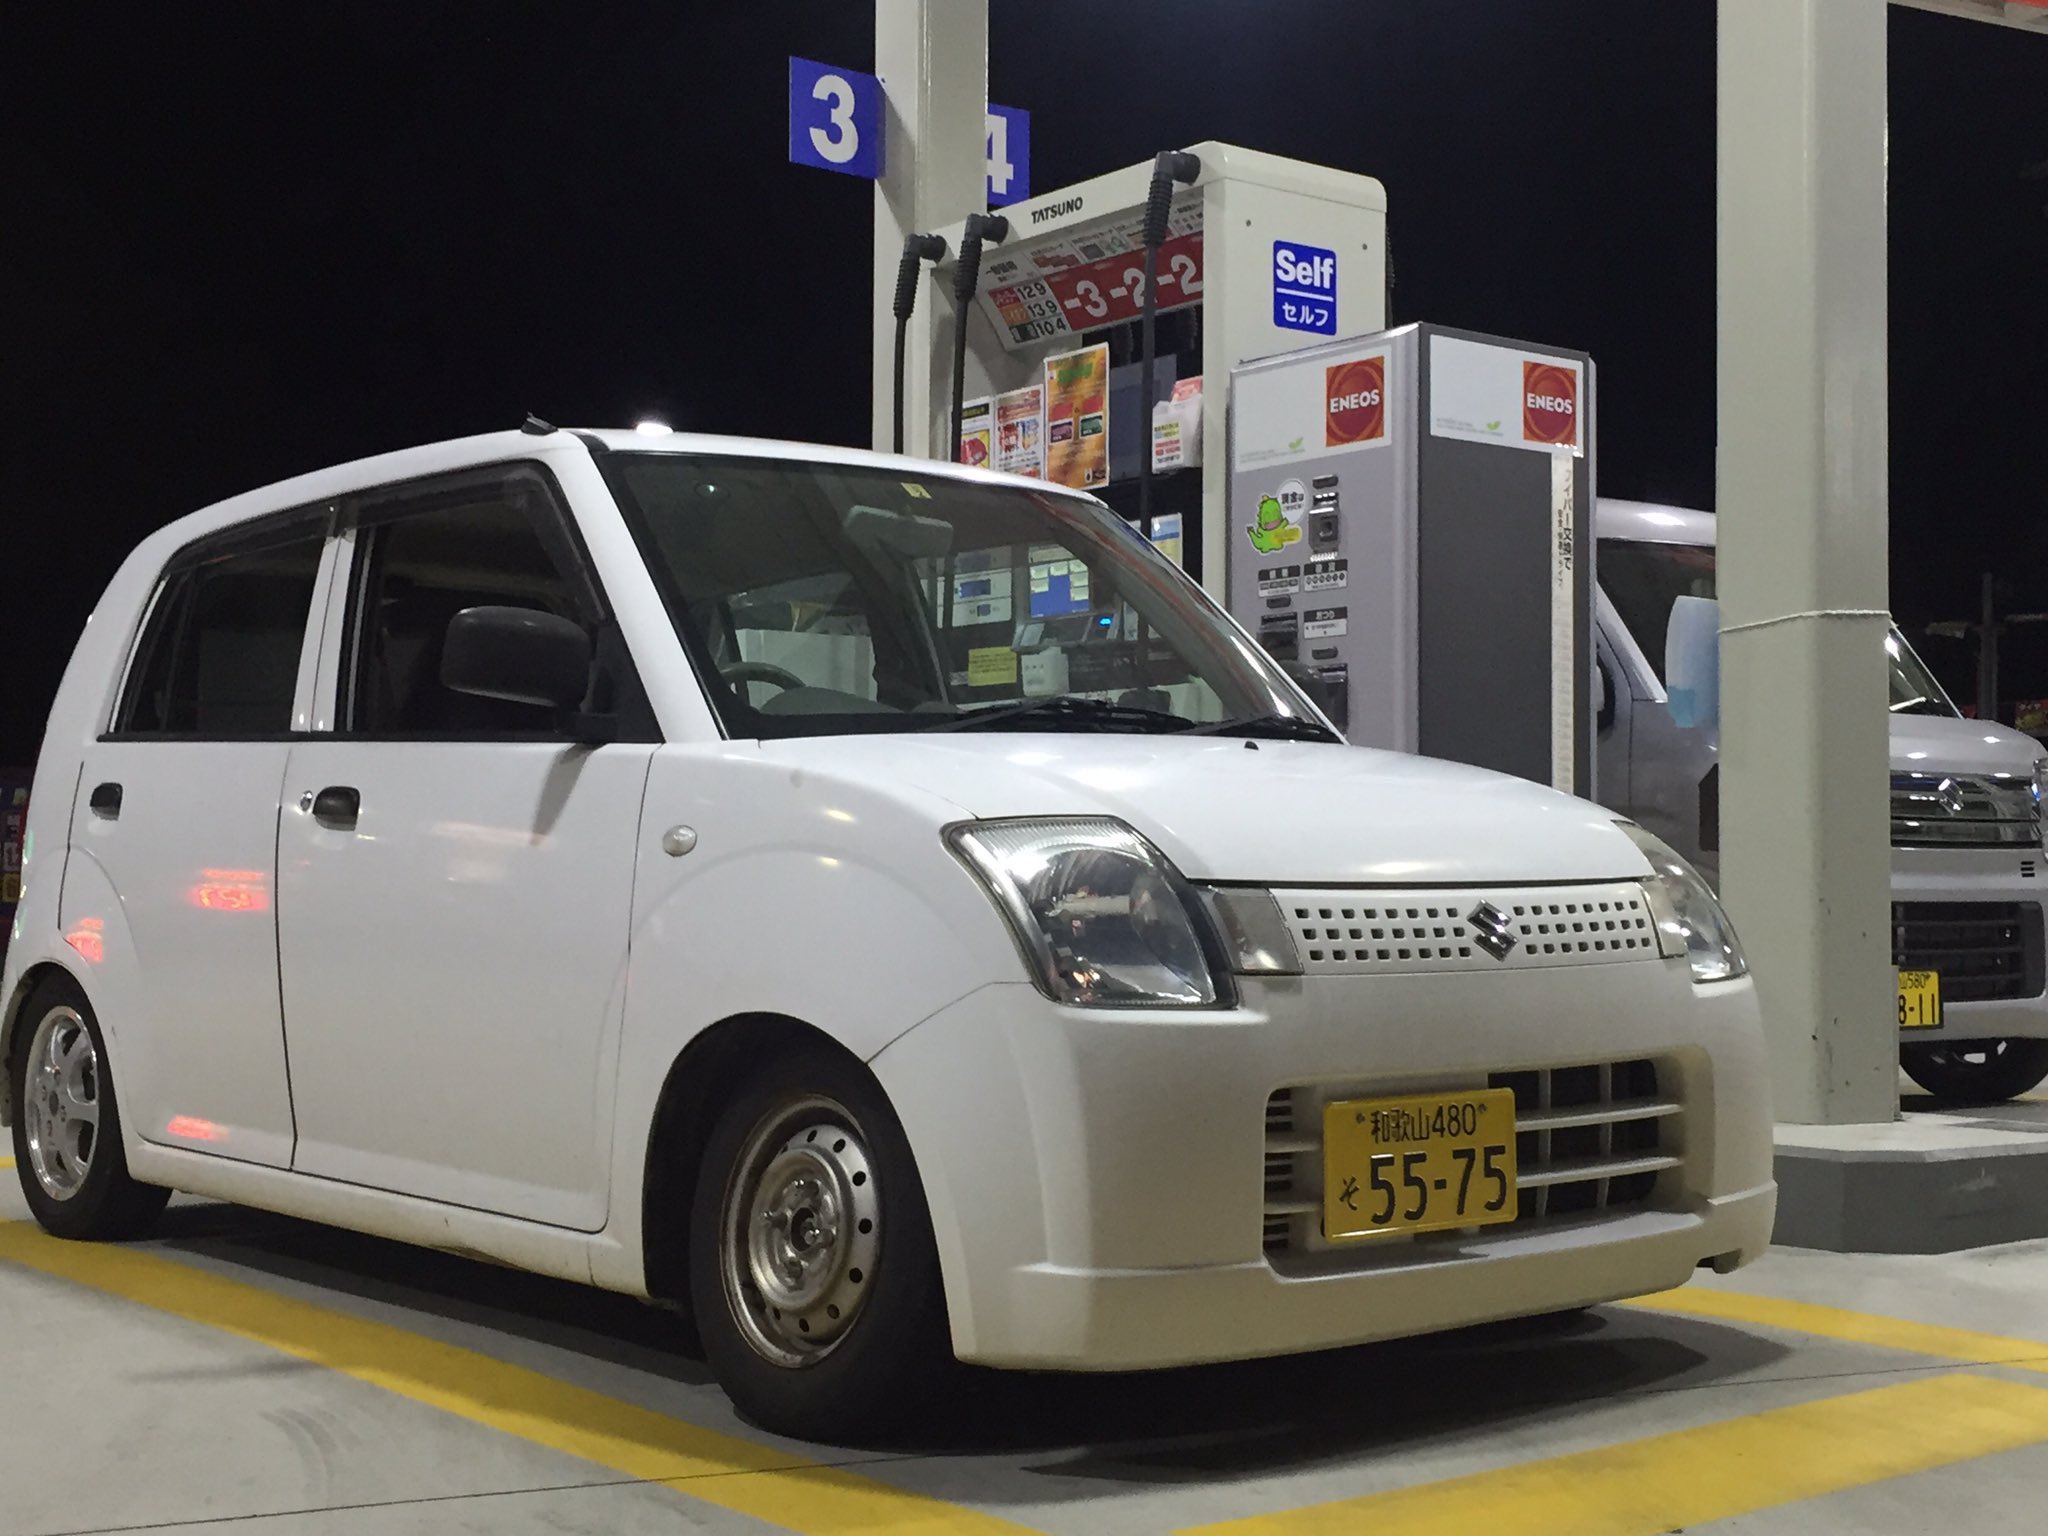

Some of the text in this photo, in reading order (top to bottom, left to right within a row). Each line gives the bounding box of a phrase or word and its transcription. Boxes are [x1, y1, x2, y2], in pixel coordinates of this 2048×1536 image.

[809, 74, 859, 164] 3
[987, 113, 1014, 195] 4
[1031, 196, 1084, 224] TATSUNO
[1276, 249, 1334, 289] Self
[1017, 282, 1048, 301] 129
[1026, 300, 1058, 319] 139
[1282, 302, 1329, 327] セルフ
[1036, 317, 1067, 337] 104
[1329, 389, 1380, 413] ENEOS
[1526, 392, 1573, 415] ENEOS
[1339, 1145, 1507, 1225] そ 55-75
